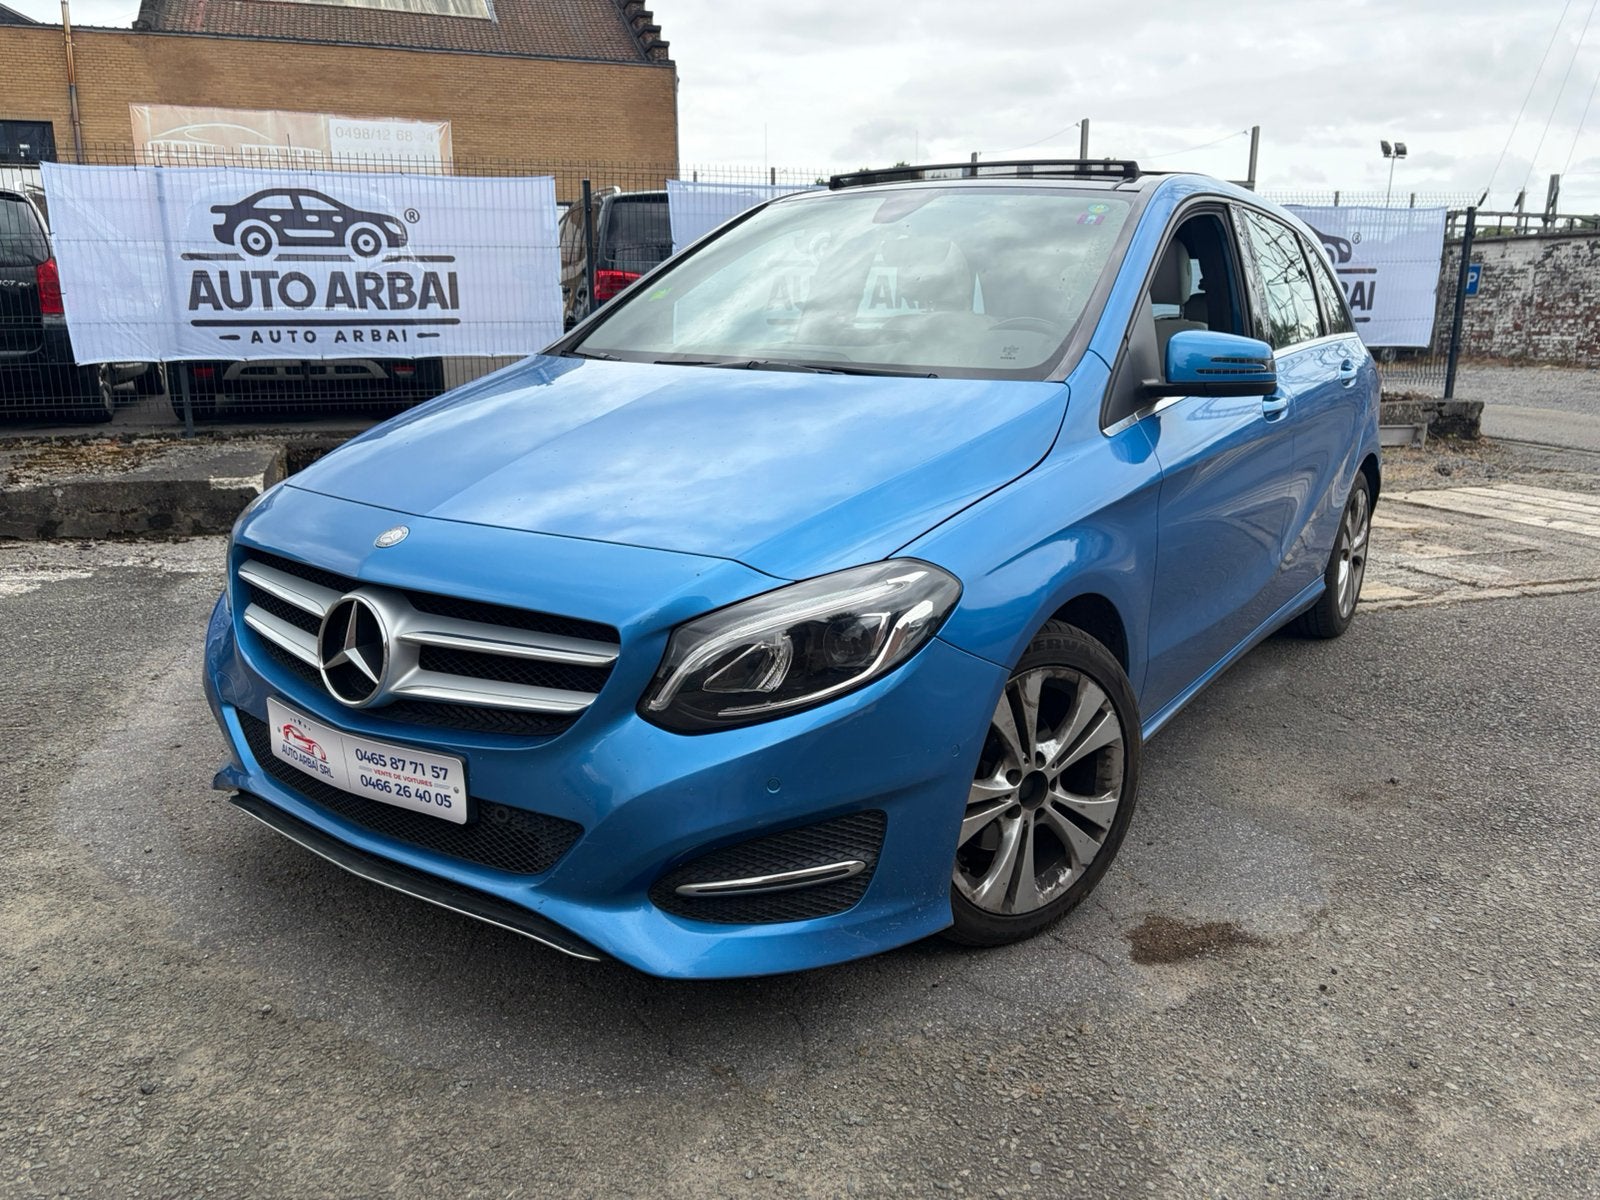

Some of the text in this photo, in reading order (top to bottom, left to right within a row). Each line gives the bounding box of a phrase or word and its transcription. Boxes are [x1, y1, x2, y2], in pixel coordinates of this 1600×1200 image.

[396, 129, 414, 142] 68
[188, 269, 460, 311] AUTO ARBAI
[1465, 272, 1478, 290] P
[251, 329, 408, 344] AUTO ARBAI
[281, 744, 299, 761] AUTO
[319, 763, 335, 779] SRL
[355, 748, 448, 780] 0465 87 71 57
[373, 768, 433, 787] VENTE DE VOITURES
[360, 774, 452, 808] 0466 26 40 05
